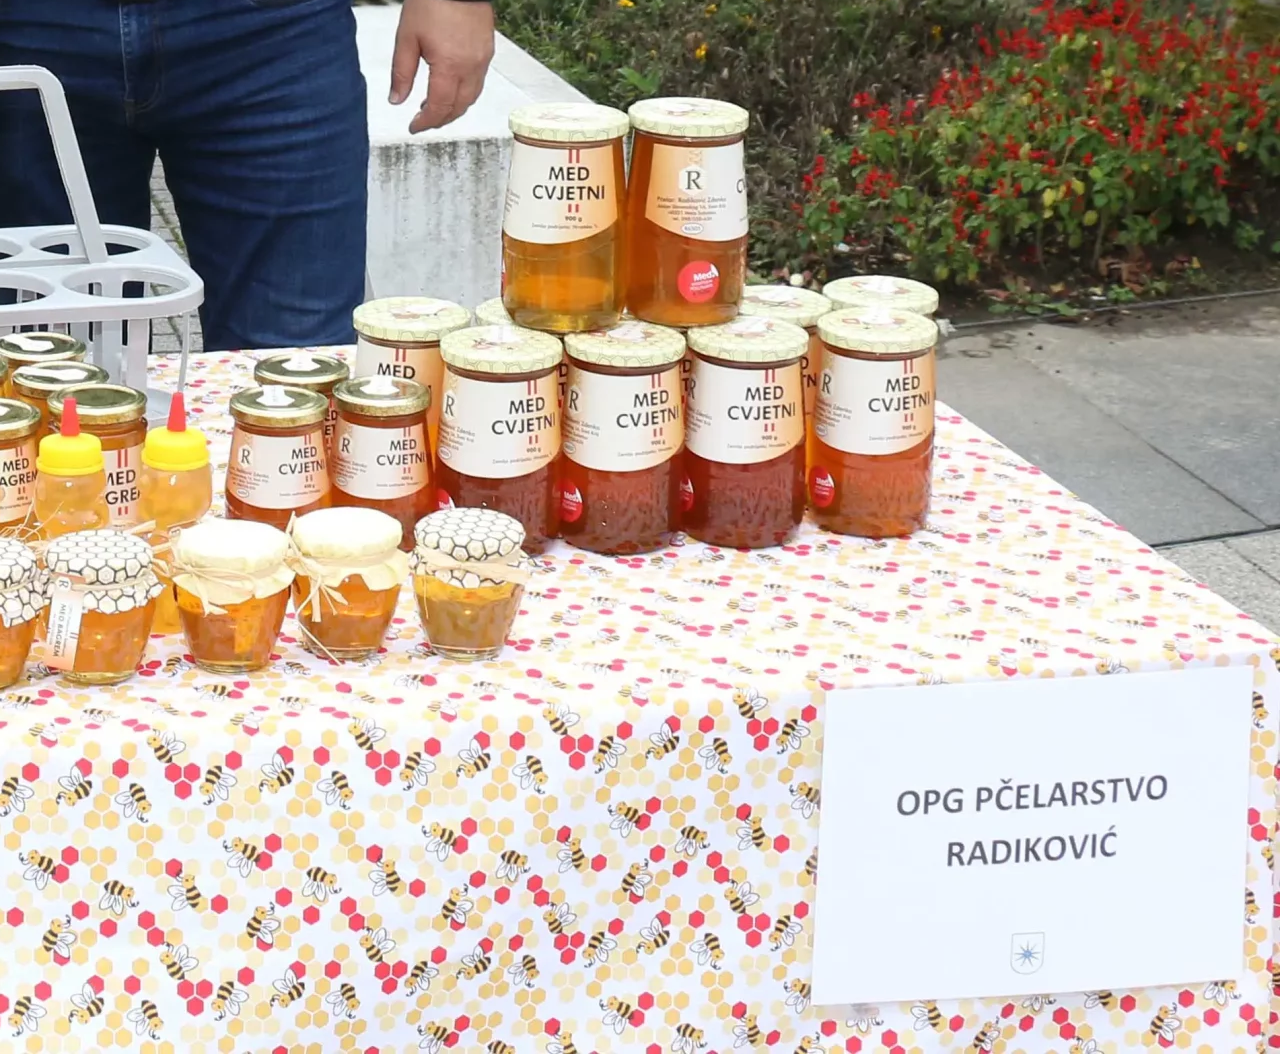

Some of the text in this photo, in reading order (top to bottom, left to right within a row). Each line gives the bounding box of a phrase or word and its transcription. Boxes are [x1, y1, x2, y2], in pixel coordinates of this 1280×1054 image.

[548, 166, 590, 181] MED
[685, 170, 702, 190] R
[532, 184, 605, 200] CVJETNI
[377, 362, 416, 379] MED
[745, 385, 784, 402] MED
[821, 373, 832, 395] R
[885, 376, 920, 393] MED
[444, 394, 455, 417] R
[509, 396, 545, 415] MED
[569, 390, 579, 412] R
[633, 389, 670, 408] MED
[868, 391, 930, 413] CVJETNI
[616, 404, 679, 429] CVJETNI
[727, 402, 796, 421] CVJETNI
[491, 412, 555, 435] CVJETNI
[291, 445, 317, 460] MED
[341, 437, 351, 454] R
[389, 438, 417, 452] MED
[2, 457, 30, 472] MED
[240, 448, 251, 465] R
[376, 452, 425, 466] CVJETNI
[278, 458, 325, 475] CVJETNI
[105, 486, 141, 506] GRE
[896, 774, 1168, 816] OPG PČELARSTVO
[946, 825, 1118, 867] RADIKOVIĆ
